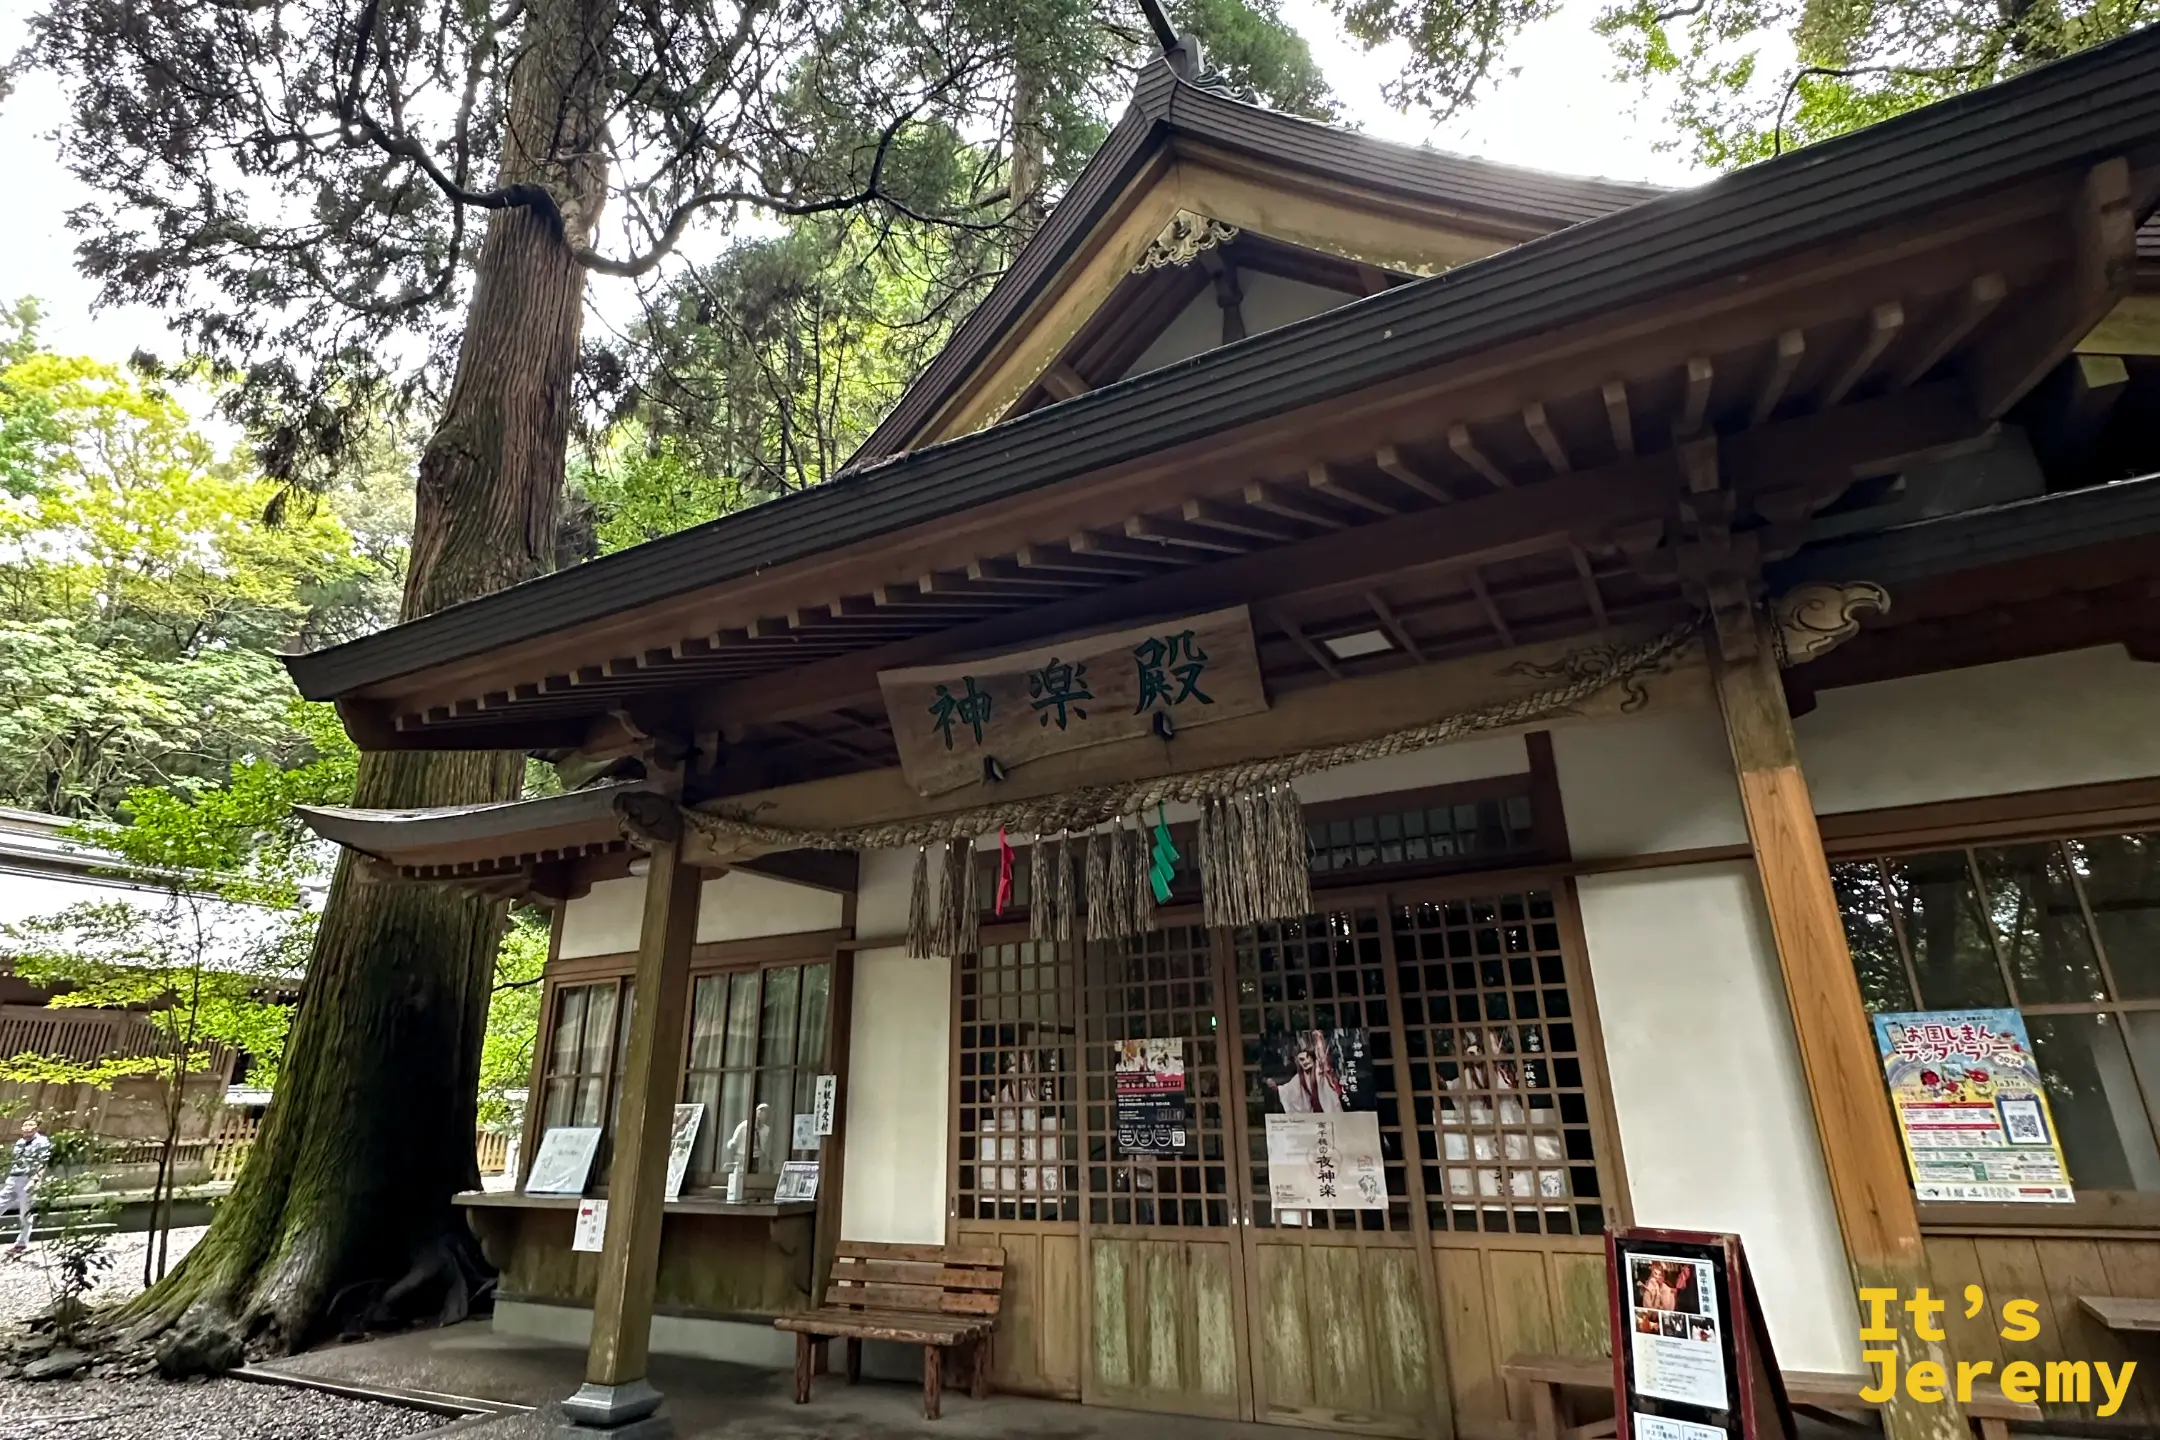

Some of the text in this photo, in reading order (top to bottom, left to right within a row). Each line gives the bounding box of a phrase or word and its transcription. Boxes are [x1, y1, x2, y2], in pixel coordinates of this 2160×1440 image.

[928, 629, 1215, 751] 神楽殿
[1998, 1055, 2022, 1066] 2024
[1316, 1121, 1337, 1198] 高千穂の夜神楽
